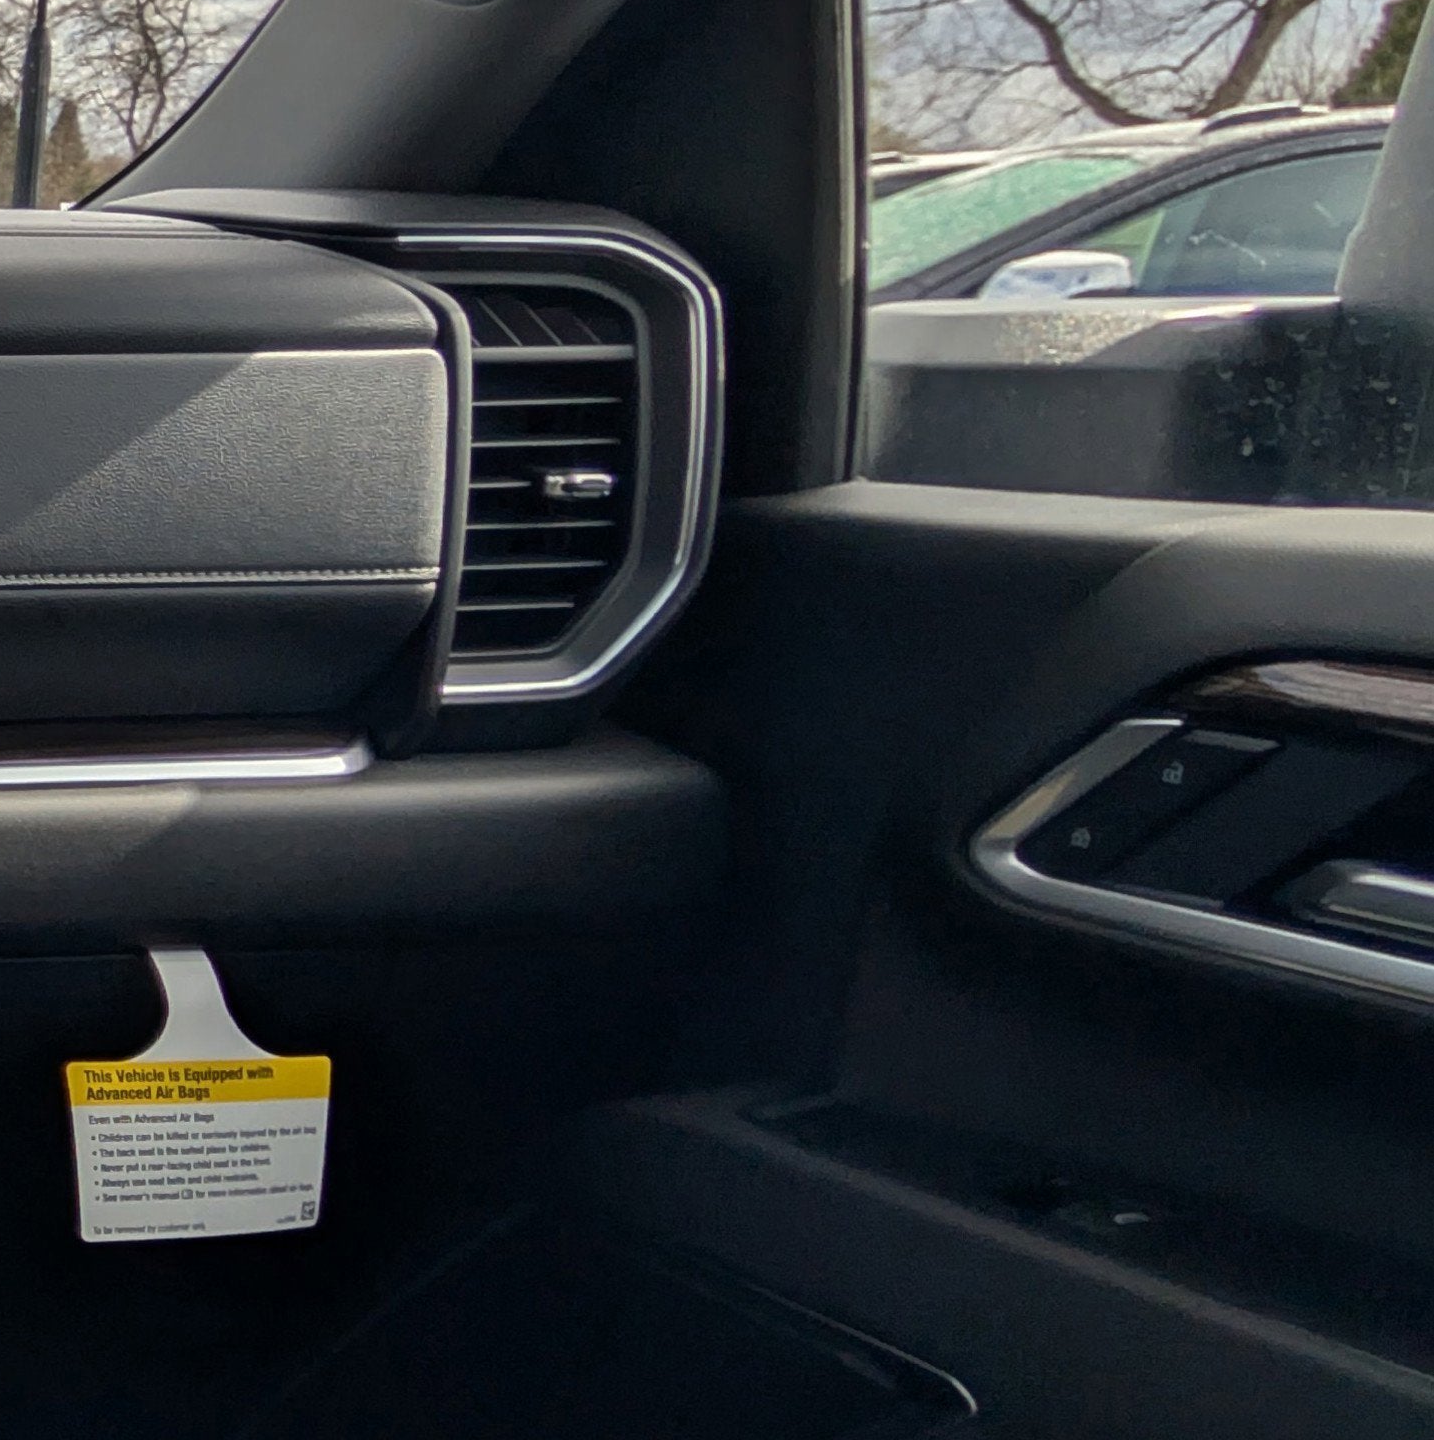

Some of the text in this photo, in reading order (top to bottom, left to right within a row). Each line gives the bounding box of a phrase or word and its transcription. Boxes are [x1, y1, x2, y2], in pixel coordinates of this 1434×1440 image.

[84, 1065, 274, 1083] This Vehicle is Equipped with
[87, 1085, 210, 1101] Advanced Air Bags
